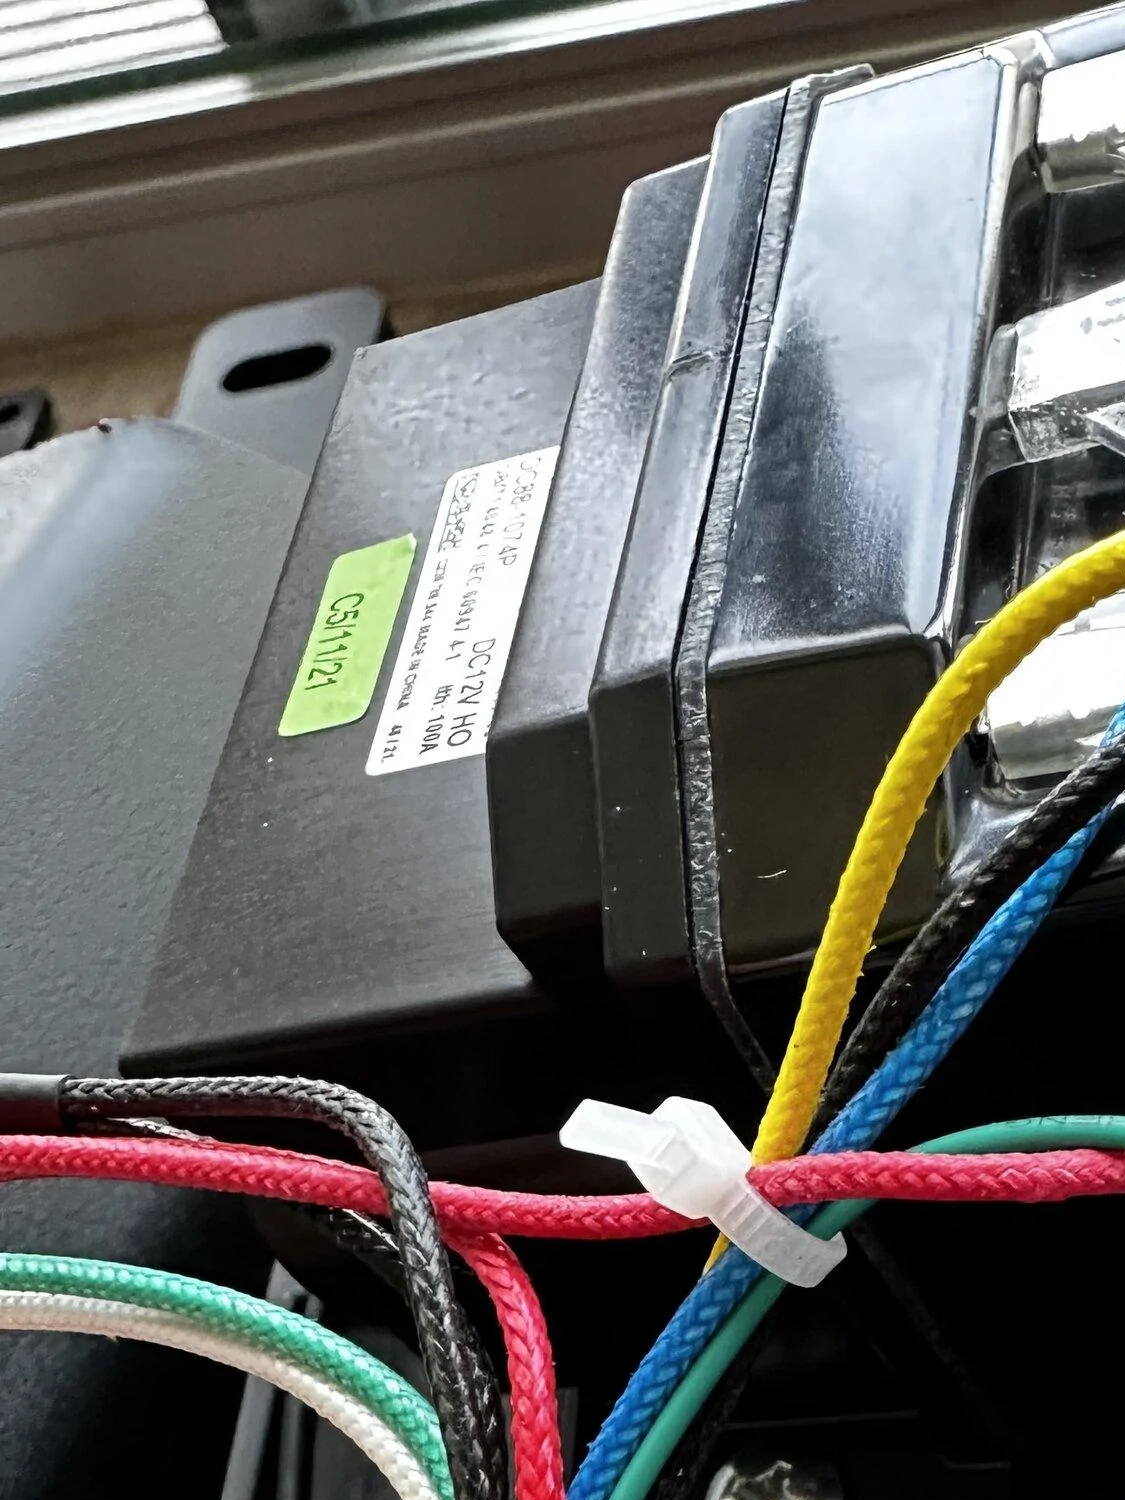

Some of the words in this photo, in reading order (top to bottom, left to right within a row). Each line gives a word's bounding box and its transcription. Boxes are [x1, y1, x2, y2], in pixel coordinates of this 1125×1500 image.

[456, 637, 497, 705] DC12V
[418, 714, 446, 756] 100A
[446, 712, 478, 748] HO
